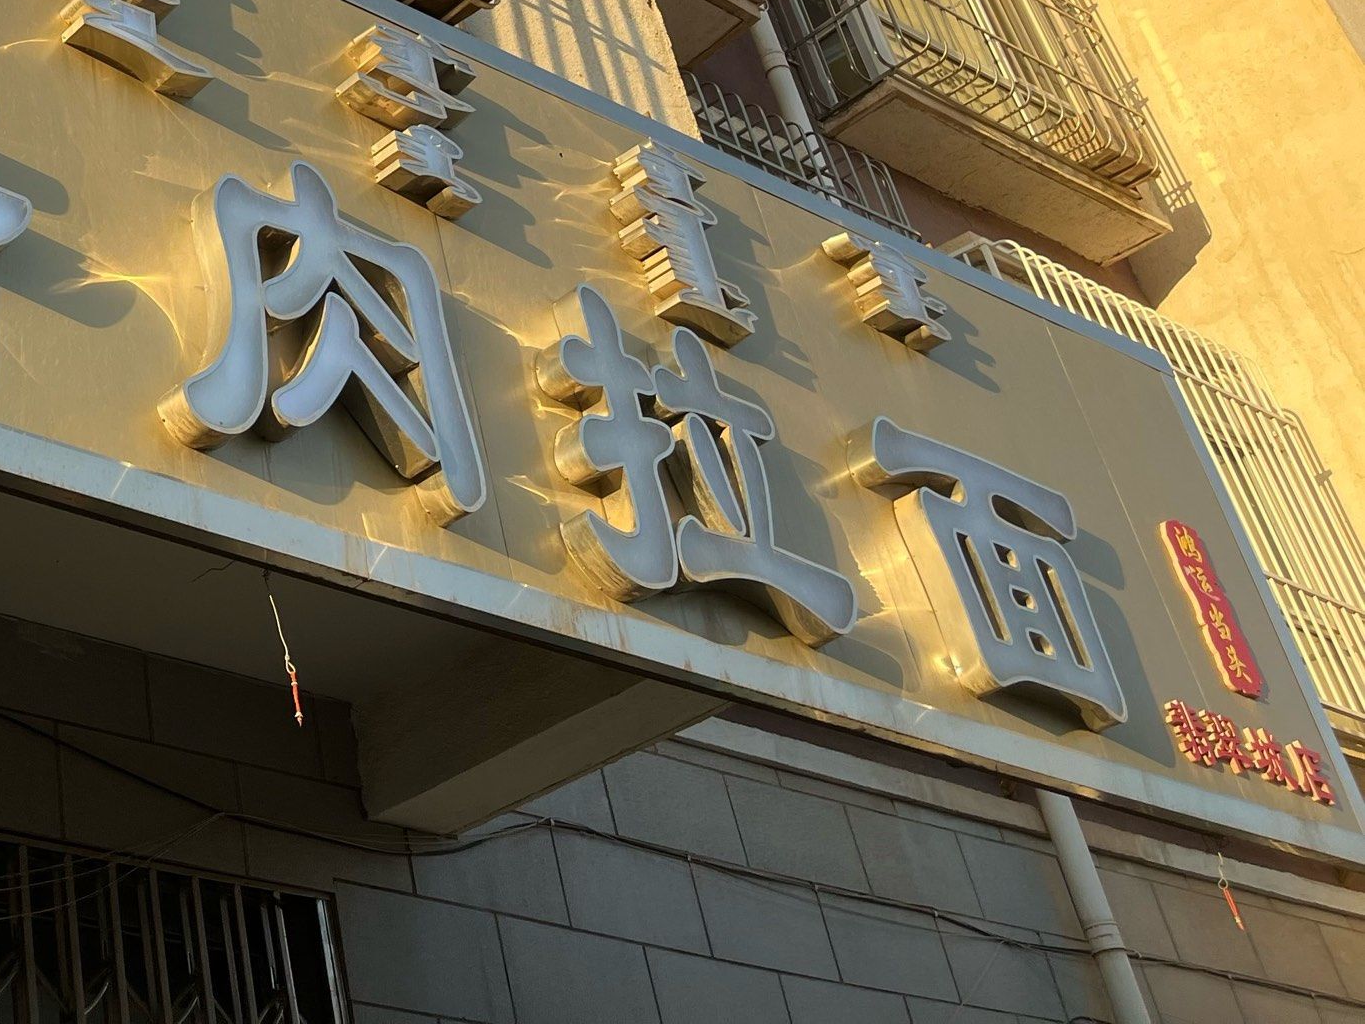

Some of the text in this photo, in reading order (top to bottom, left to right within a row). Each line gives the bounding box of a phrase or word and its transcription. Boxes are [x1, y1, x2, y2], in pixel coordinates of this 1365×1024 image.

[1173, 525, 1255, 684] 鸿运当头
[1163, 699, 1336, 806] 翡翠城店
